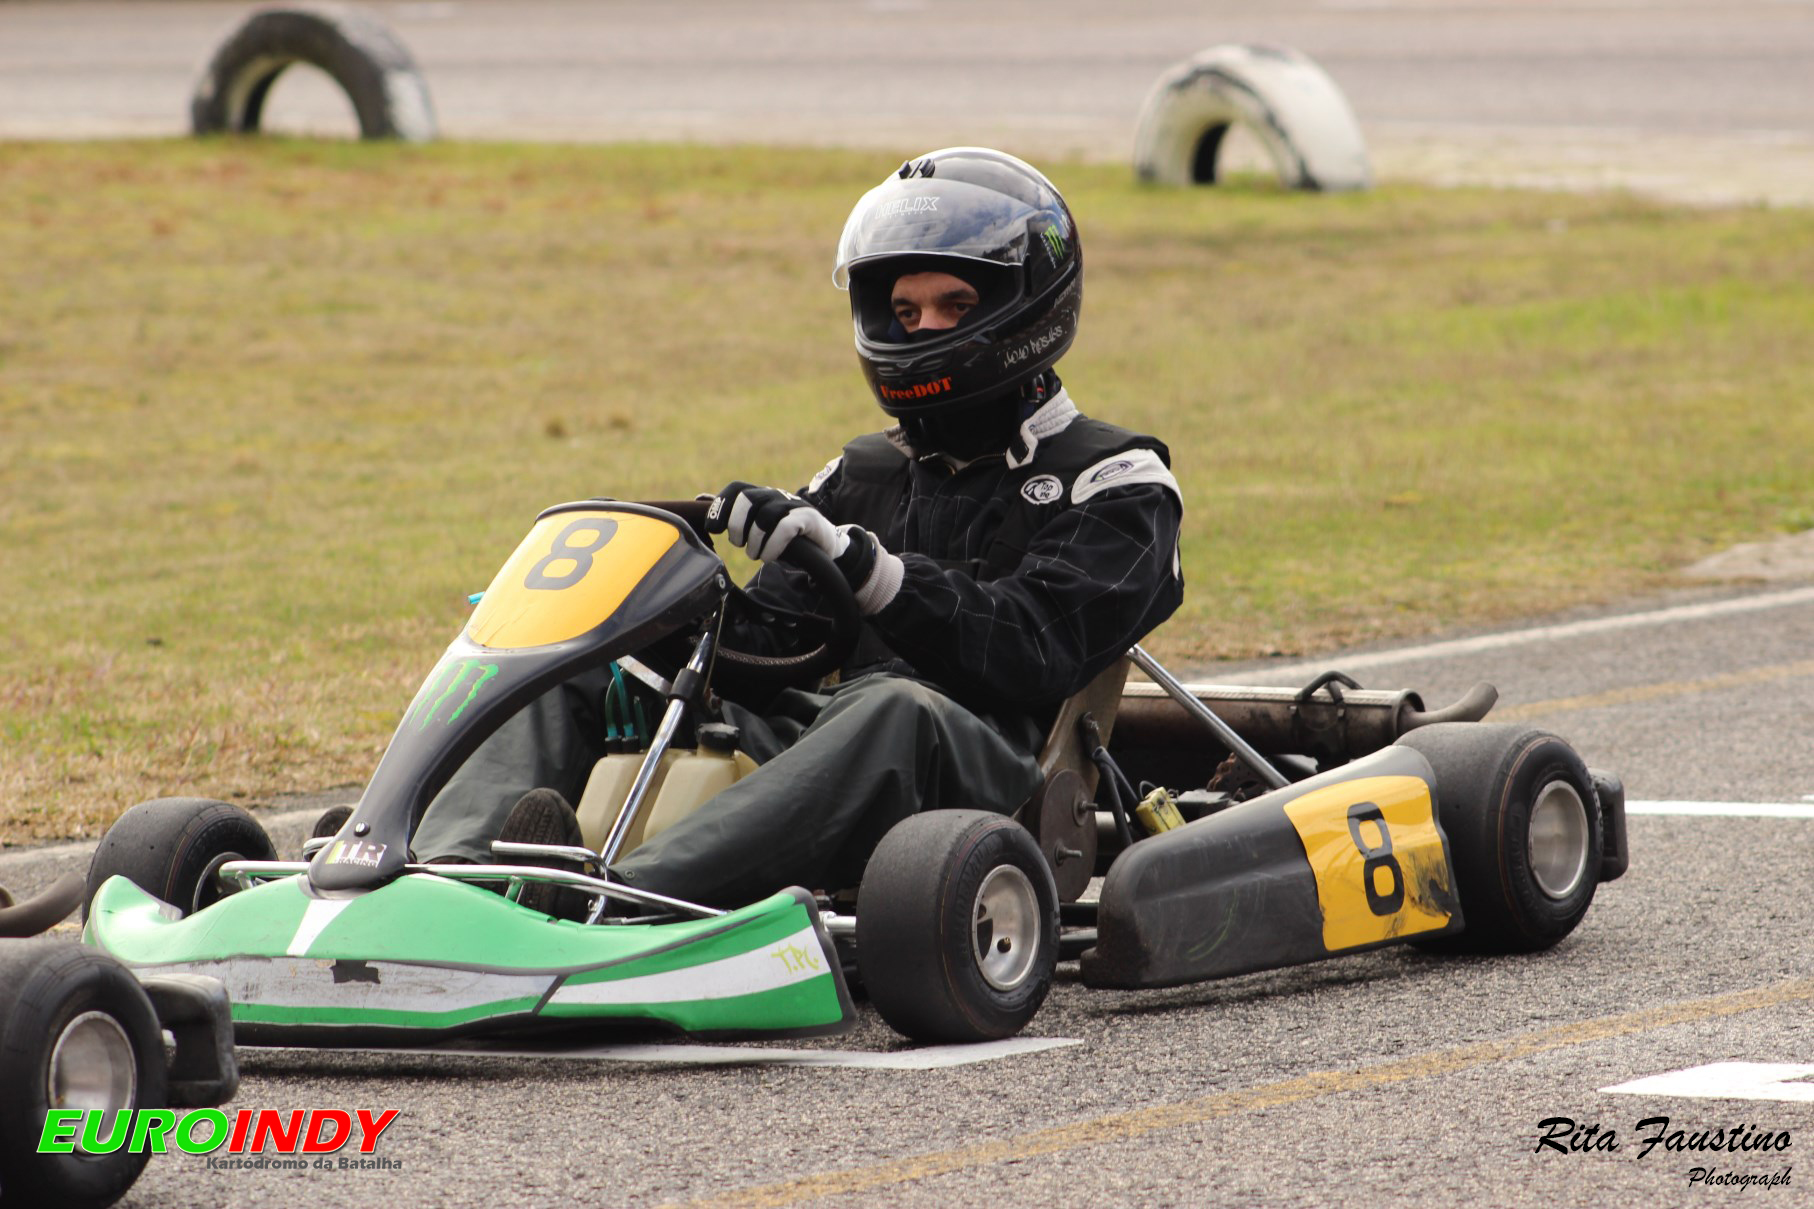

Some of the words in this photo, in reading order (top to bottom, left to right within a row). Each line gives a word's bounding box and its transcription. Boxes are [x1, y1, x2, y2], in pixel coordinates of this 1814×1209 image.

[880, 376, 952, 399] FreeDOT
[523, 517, 619, 591] 8
[1346, 801, 1405, 917] 8
